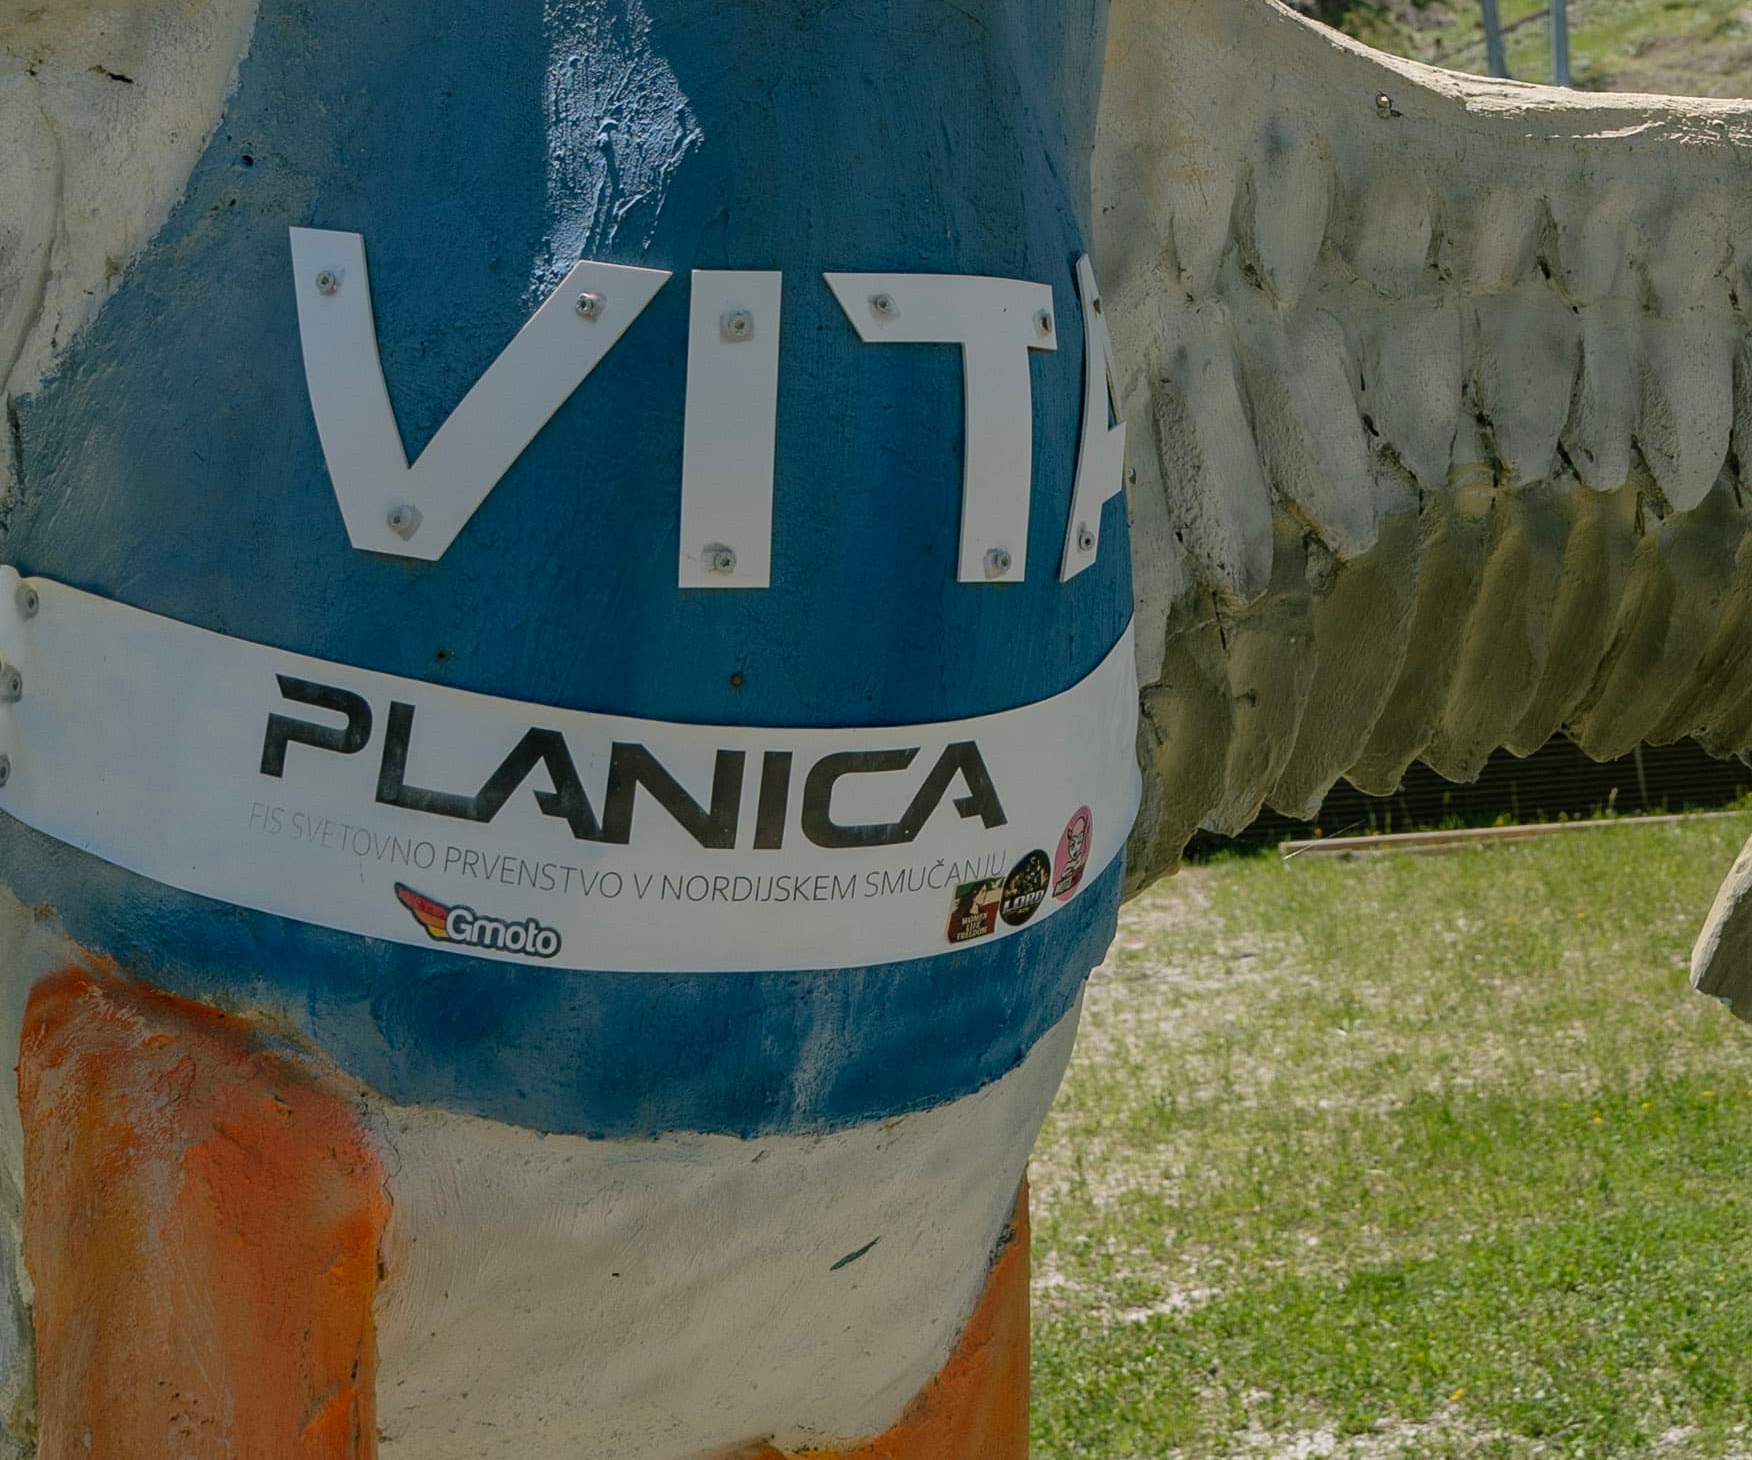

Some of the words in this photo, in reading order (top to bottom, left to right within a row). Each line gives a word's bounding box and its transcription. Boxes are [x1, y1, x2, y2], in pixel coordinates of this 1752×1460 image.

[260, 674, 1007, 849] PLANICA
[249, 801, 283, 835] FIS
[290, 811, 436, 869] SVETOVNO
[444, 846, 623, 898] PRVENSTVO
[633, 873, 653, 900] V
[661, 874, 856, 903] NORDIJSKEM
[863, 850, 1007, 898] SMUČANJU
[445, 907, 560, 957] Gmoto
